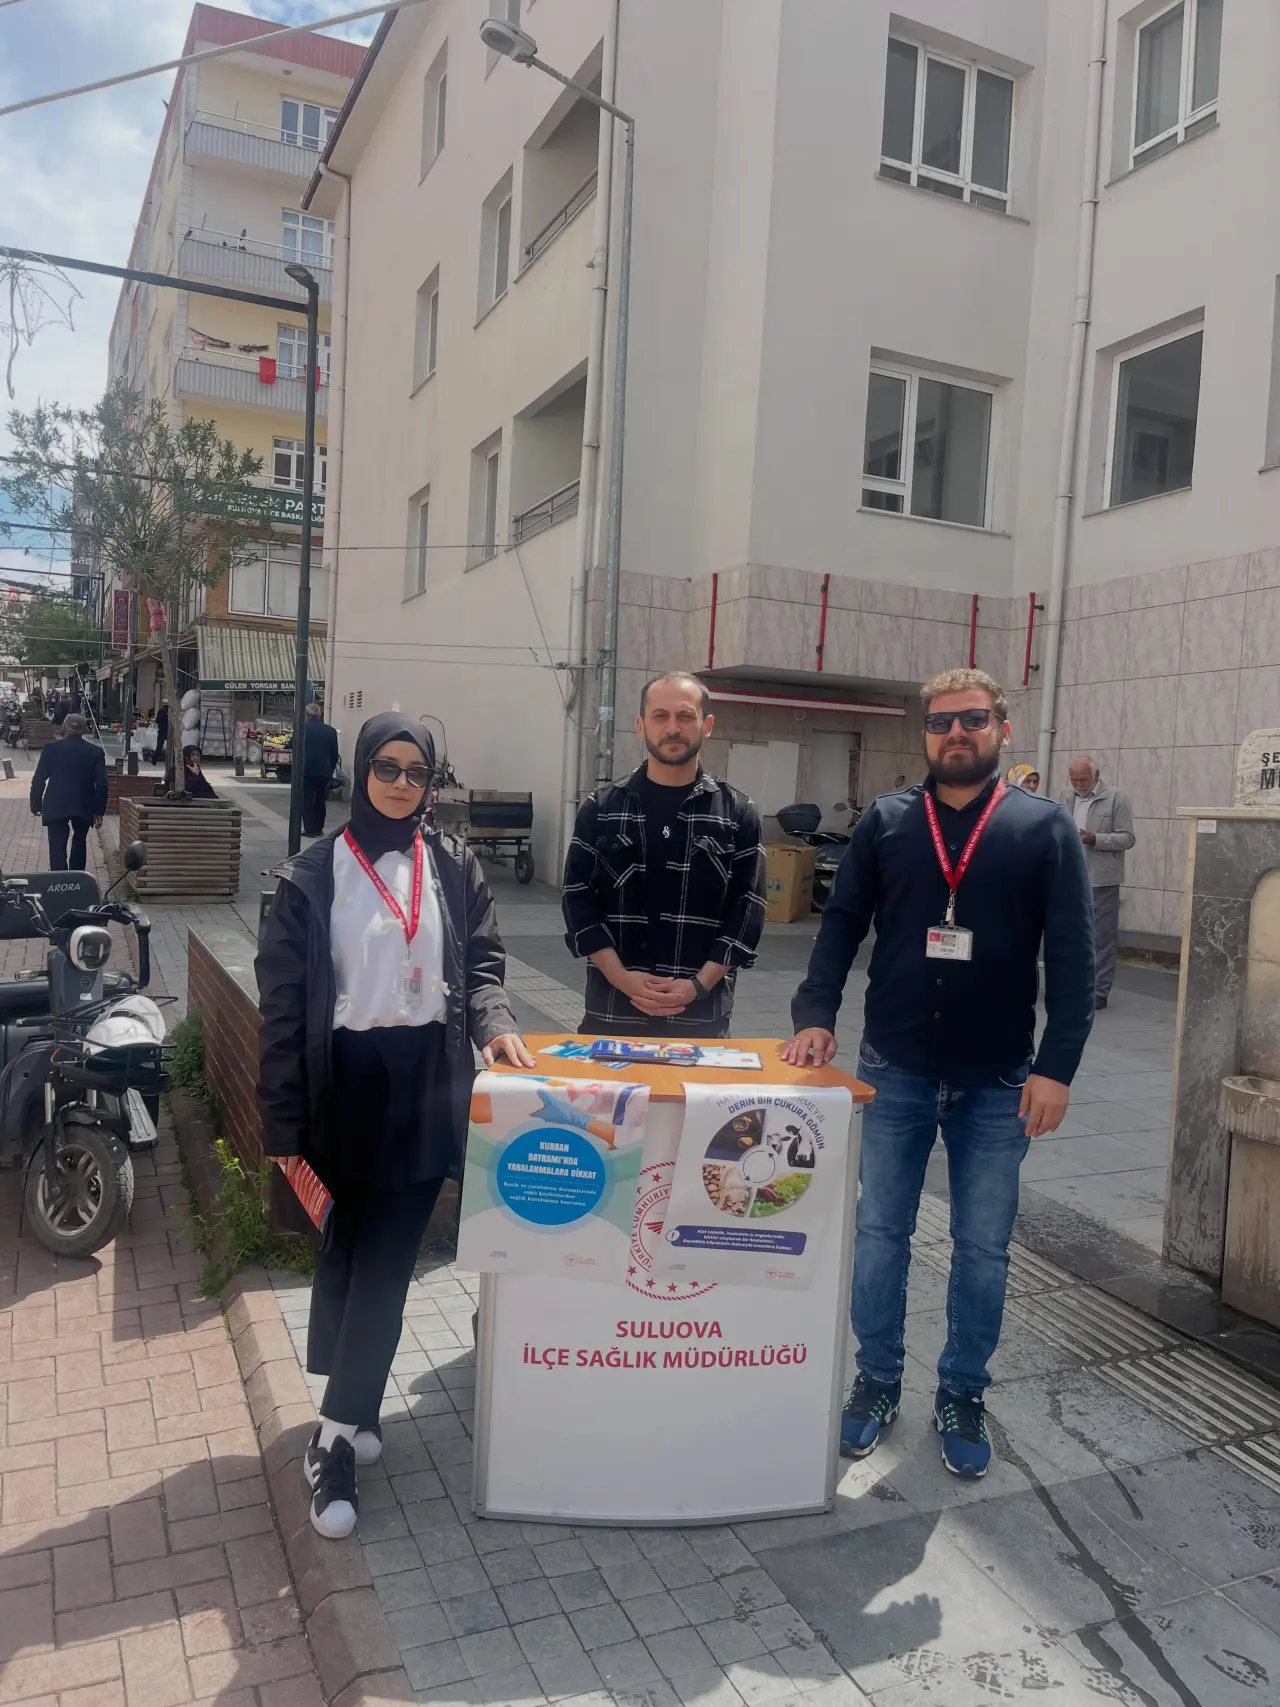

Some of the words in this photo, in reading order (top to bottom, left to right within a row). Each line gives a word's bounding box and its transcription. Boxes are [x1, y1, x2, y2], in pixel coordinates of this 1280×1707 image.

[224, 681, 247, 689] GÜLEN
[356, 850, 370, 869] AMASYA
[962, 842, 974, 863] AMASYA
[47, 883, 80, 893] ARORA
[728, 1097, 756, 1115] DERİN
[757, 1096, 772, 1105] BİR
[774, 1097, 808, 1121] ÇUKURA
[806, 1118, 825, 1150] GÖMÜN
[539, 1141, 570, 1153] KURBAN
[528, 1152, 578, 1166] BAYRAMI'NDA
[507, 1162, 569, 1177] YARALANMALARA
[571, 1168, 597, 1179] DİKKAT
[632, 1186, 671, 1229] CUMHURİY
[631, 1232, 652, 1268] ÜRKİYE
[616, 1320, 723, 1339] SULUOVA
[523, 1342, 570, 1370] İLÇE
[576, 1346, 656, 1369] SAĞLIK
[662, 1342, 807, 1369] MÜDÜRLÜĞÜ
